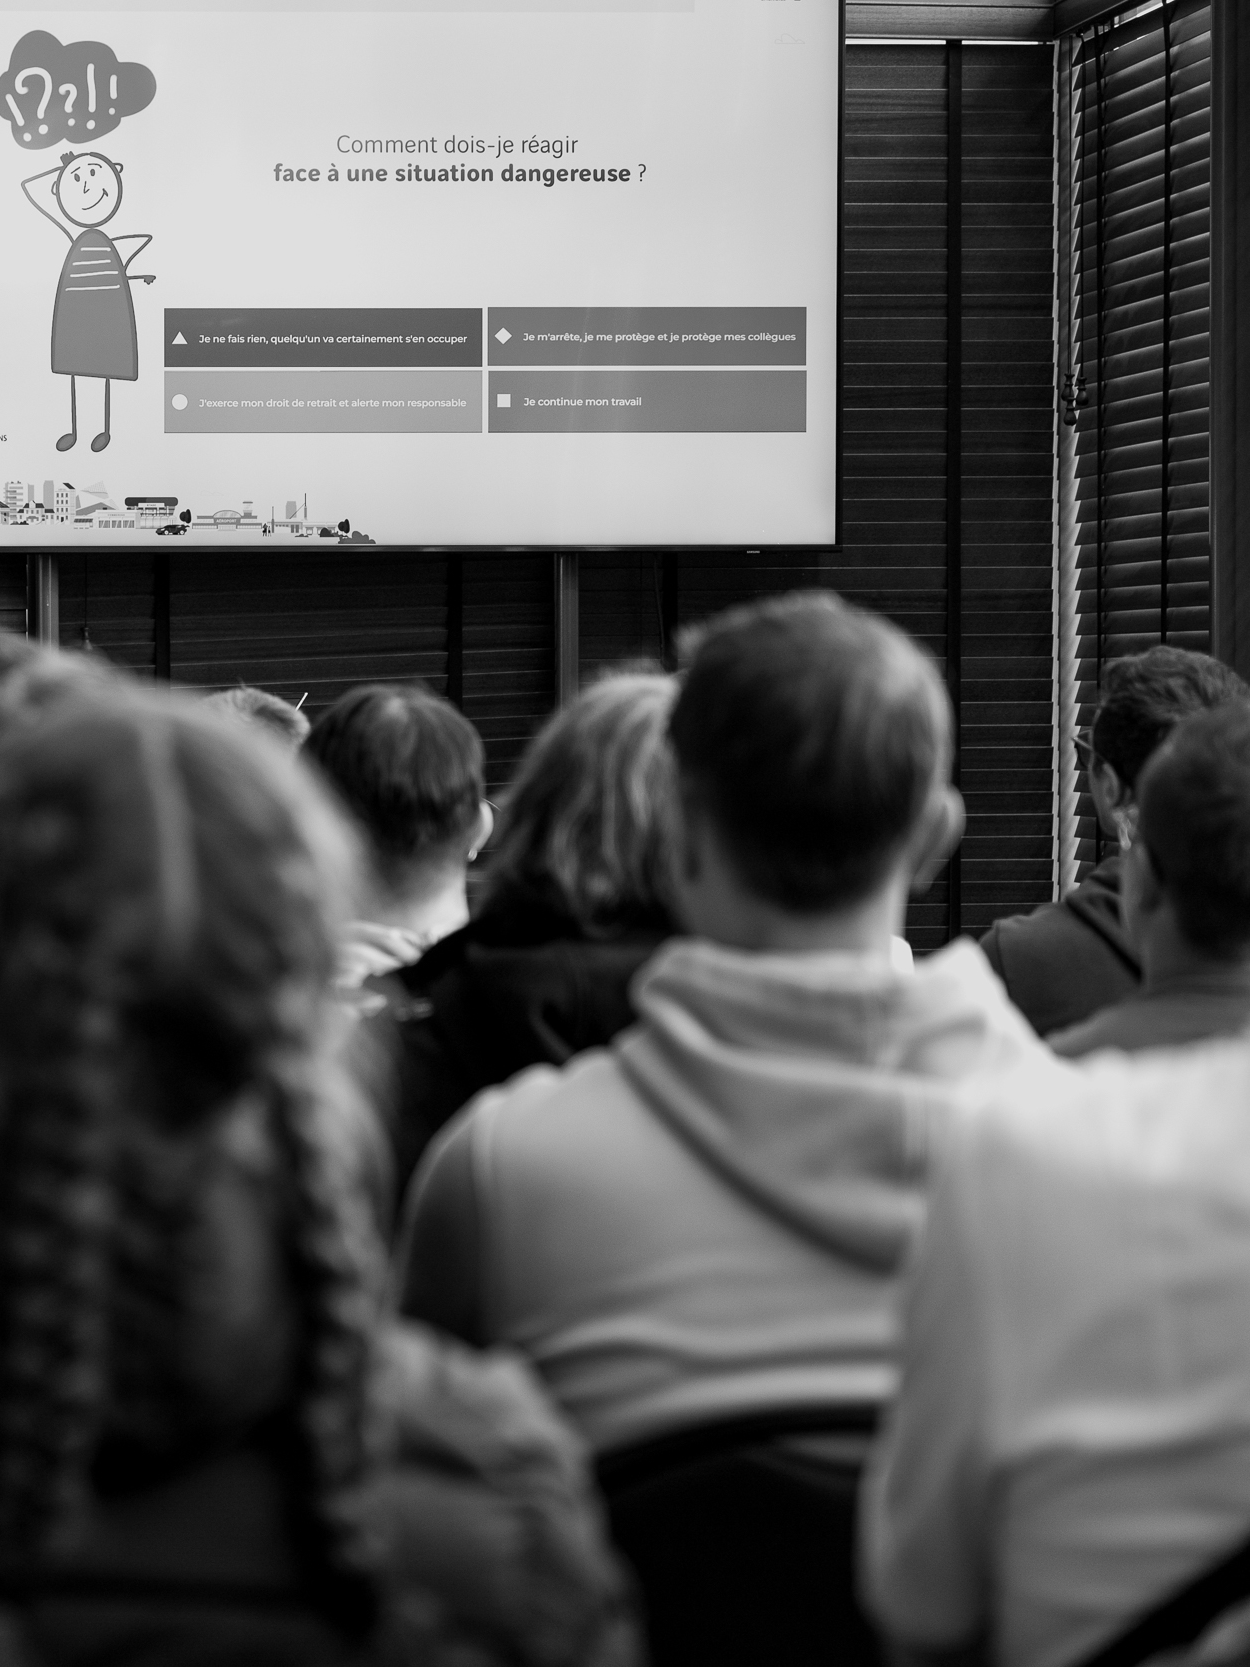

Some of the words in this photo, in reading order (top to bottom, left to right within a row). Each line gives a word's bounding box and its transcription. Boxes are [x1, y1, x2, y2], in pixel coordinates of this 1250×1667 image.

[336, 134, 439, 154] Comment
[443, 134, 515, 159] dois-je
[521, 134, 579, 159] réagir
[273, 162, 321, 183] face
[327, 162, 340, 183] à
[346, 168, 389, 183] une
[395, 162, 494, 183] situation
[500, 162, 632, 188] dangereuse
[637, 163, 647, 183] ?
[199, 334, 211, 343] Je
[228, 334, 245, 343] fais
[247, 334, 269, 345] rien,
[270, 334, 321, 345] quelqu'un
[336, 334, 404, 343] certainement
[405, 335, 425, 343] s'en
[427, 336, 468, 345] occuper
[523, 332, 535, 342] Je
[537, 332, 583, 343] m'arrête,
[583, 332, 594, 343] je
[596, 334, 613, 342] me
[615, 332, 655, 343] protège
[657, 333, 668, 342] et
[669, 332, 680, 343] je
[682, 332, 722, 343] protège
[724, 334, 746, 342] mes
[748, 332, 797, 343] collègues
[199, 398, 239, 408] J'exerce
[241, 400, 264, 408] mon
[266, 398, 290, 408] droit
[292, 398, 305, 408] de
[307, 398, 337, 408] retrait
[339, 399, 350, 408] et
[352, 398, 380, 408] alerte
[382, 400, 405, 408] mon
[408, 398, 467, 409] responsable
[524, 397, 536, 407] Je
[538, 397, 584, 407] continue
[586, 399, 609, 407] mon
[611, 397, 642, 407] travail
